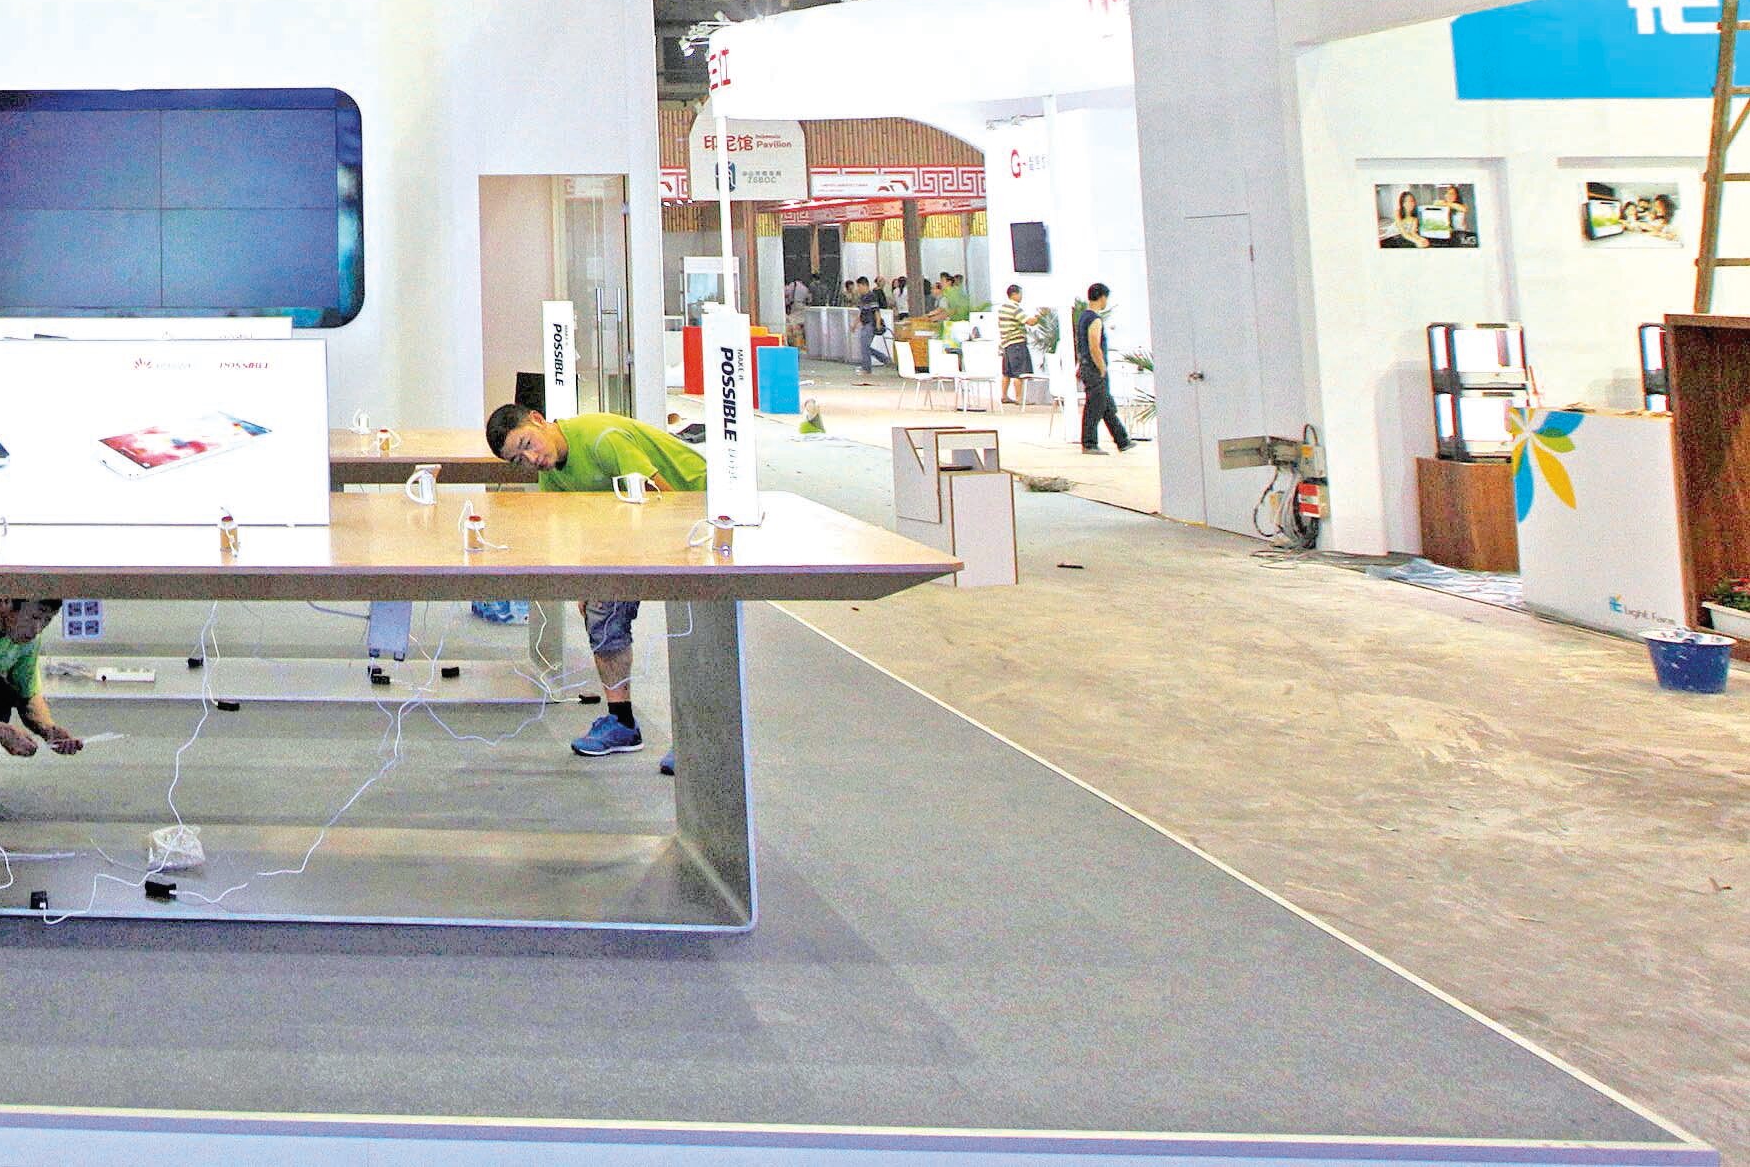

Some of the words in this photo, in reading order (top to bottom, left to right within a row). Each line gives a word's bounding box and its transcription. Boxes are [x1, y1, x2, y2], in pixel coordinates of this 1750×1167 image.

[756, 140, 792, 149] Pavilion
[553, 322, 564, 386] POSSIBLE
[720, 346, 738, 442] POSSIBLE
